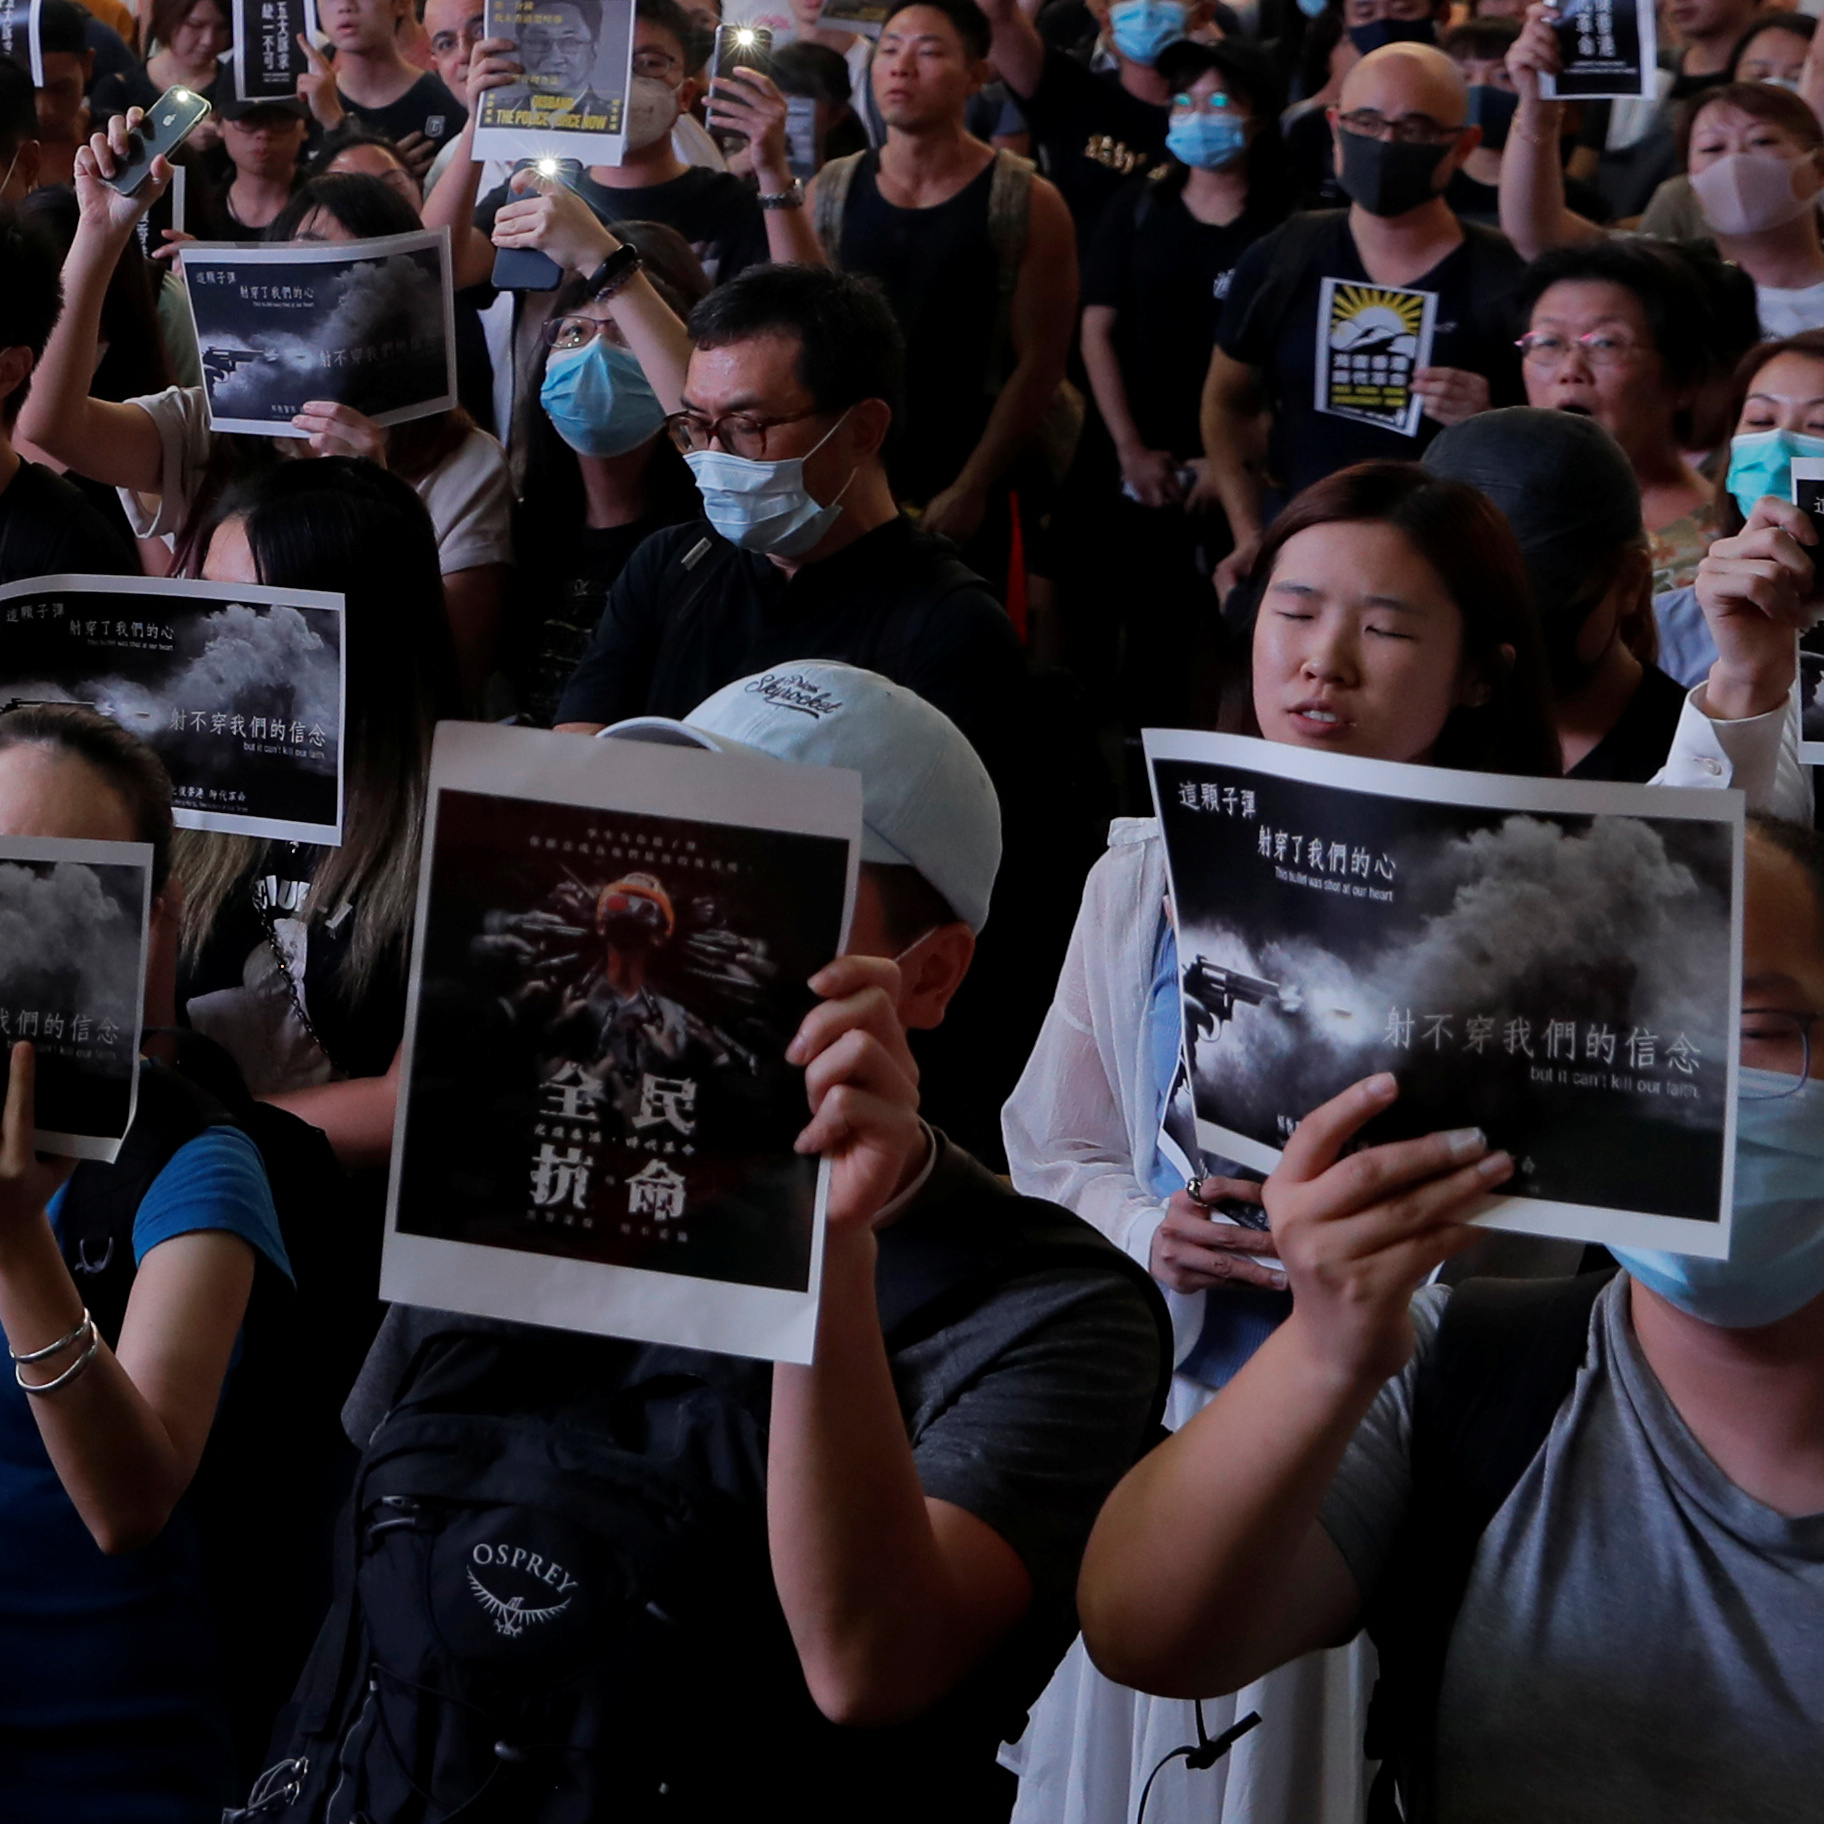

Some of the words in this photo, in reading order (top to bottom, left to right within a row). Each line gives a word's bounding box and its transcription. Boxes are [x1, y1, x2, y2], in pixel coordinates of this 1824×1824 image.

[5, 602, 65, 623] 這顆子彈
[69, 619, 175, 641] 射穿了我們的心
[169, 708, 327, 748] 射不穿我們的信念
[1179, 781, 1256, 819] 這顆子彈
[1258, 825, 1396, 881] 射穿了我們的心
[1383, 1005, 1701, 1075] 射不穿我們的信念
[538, 1061, 698, 1136] 全民
[1637, 1079, 1661, 1095] our
[531, 1143, 687, 1221] 抗命
[473, 1543, 578, 1593] OSPREY
